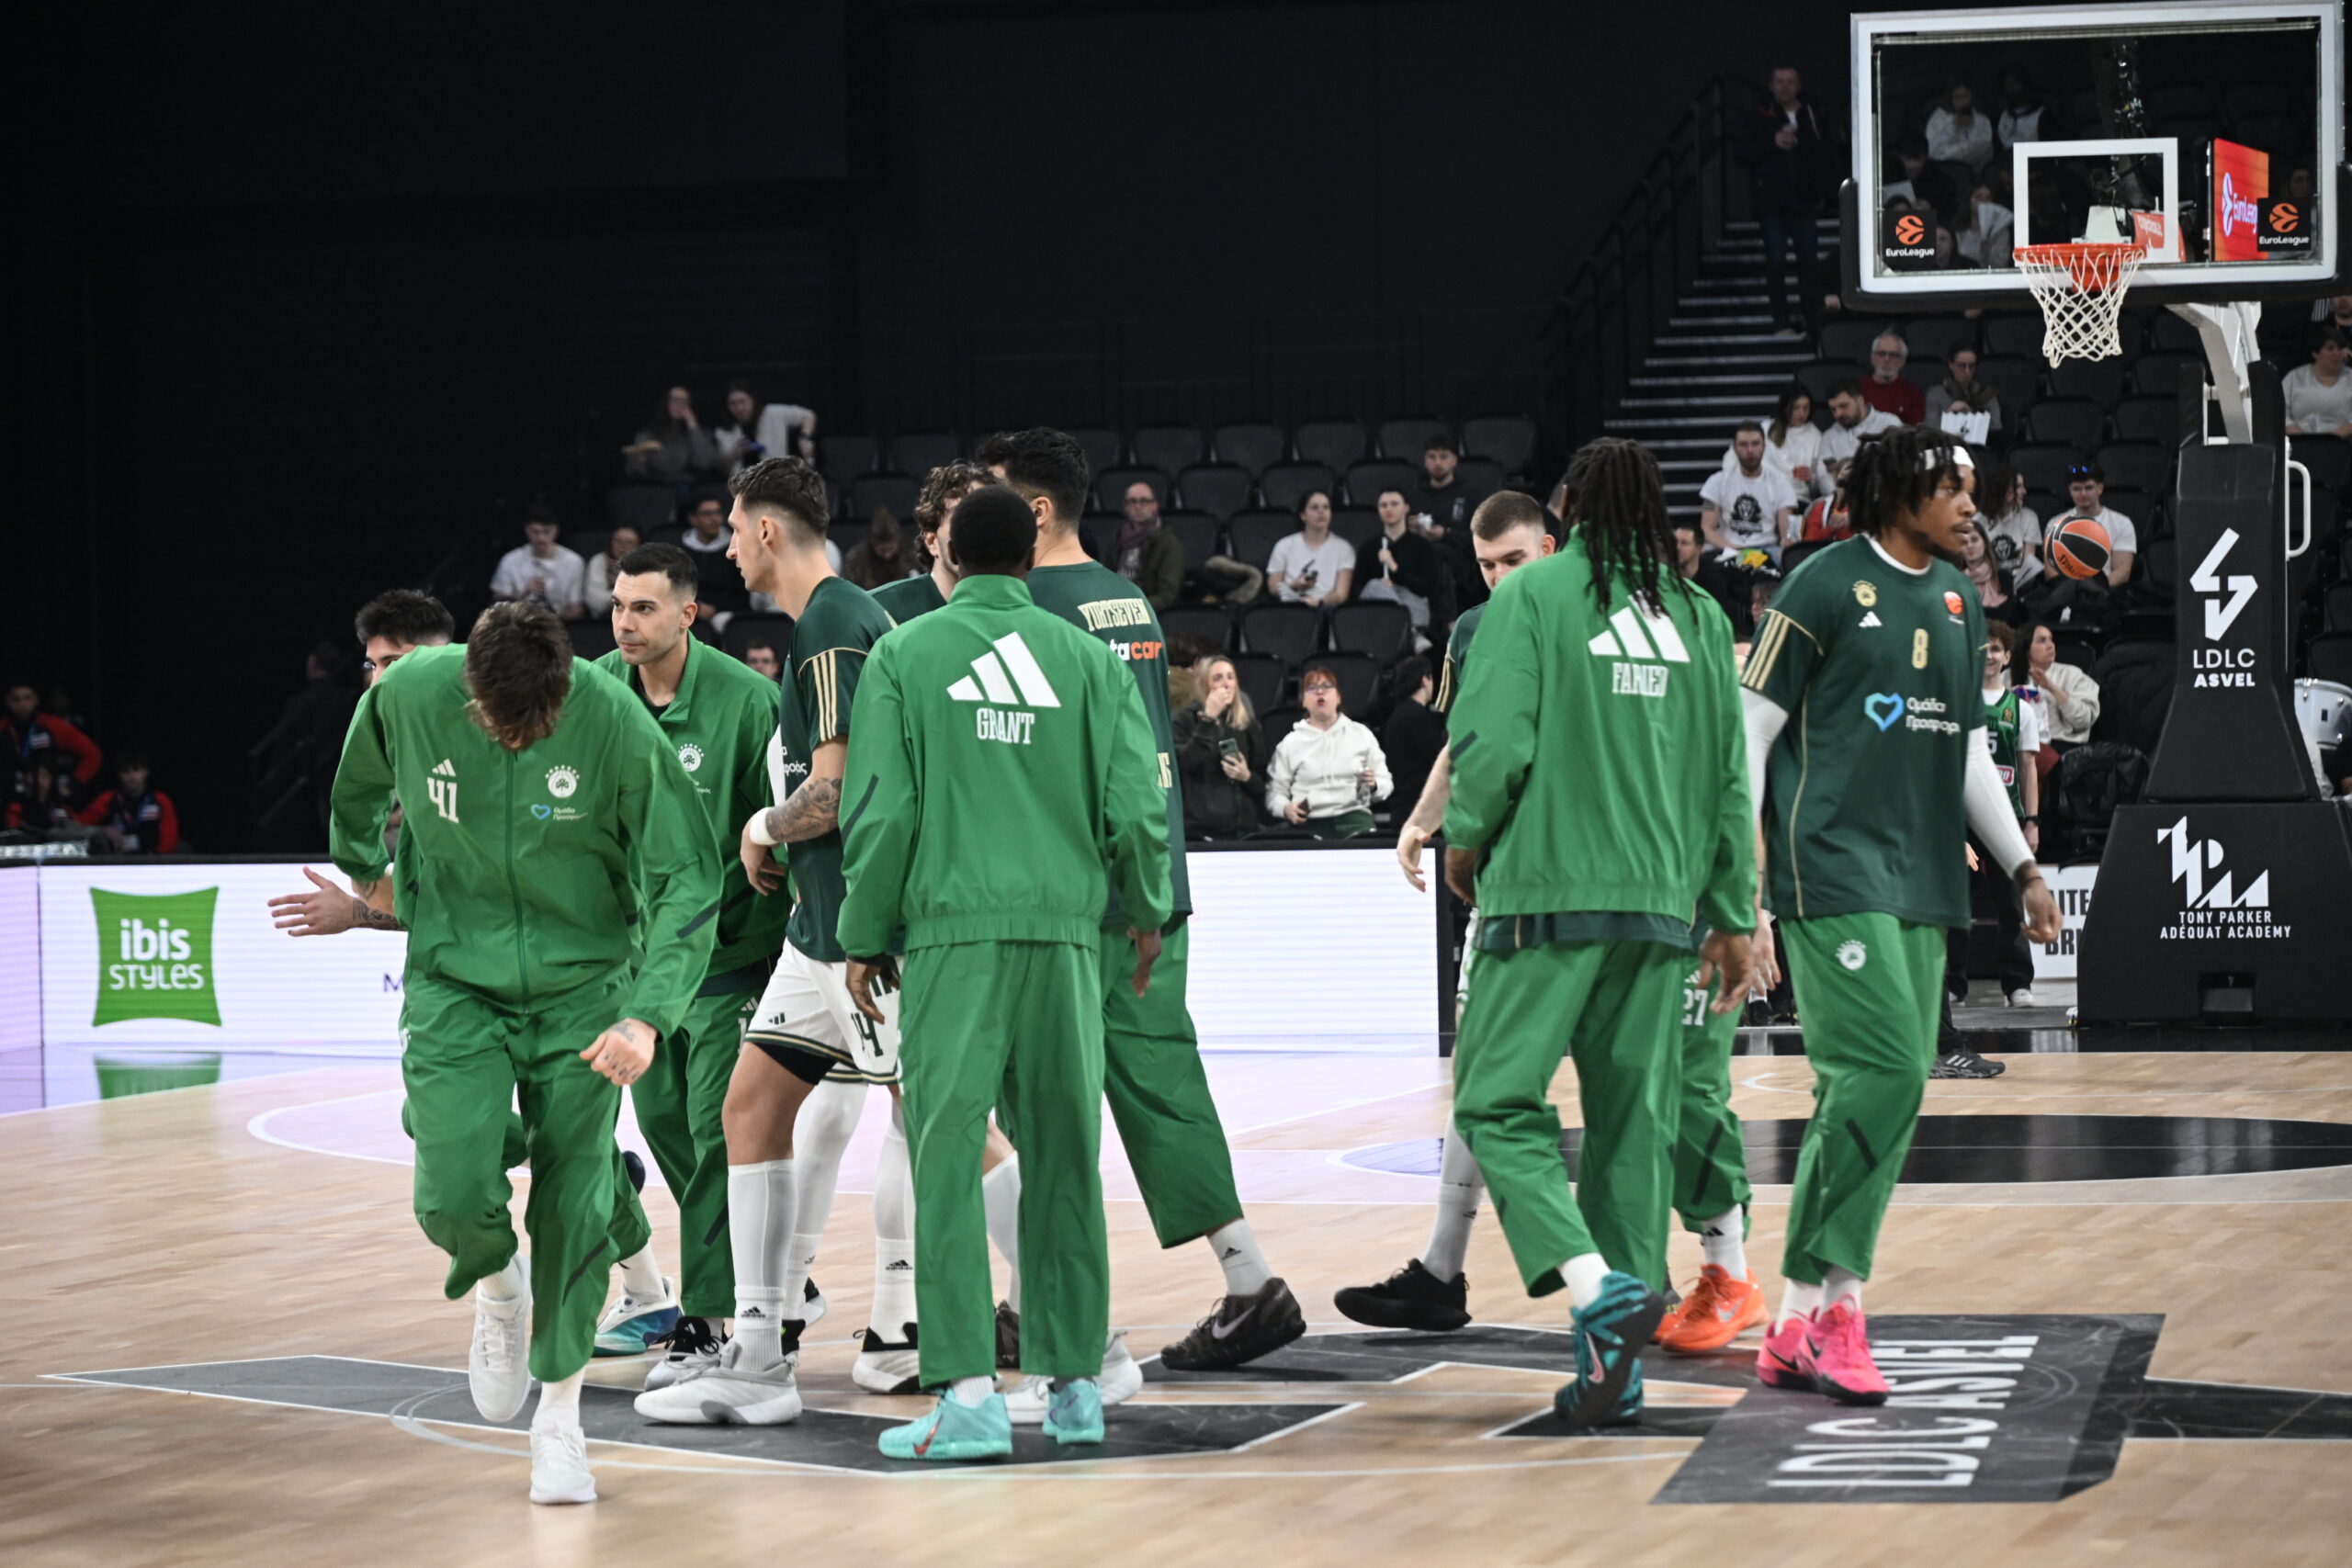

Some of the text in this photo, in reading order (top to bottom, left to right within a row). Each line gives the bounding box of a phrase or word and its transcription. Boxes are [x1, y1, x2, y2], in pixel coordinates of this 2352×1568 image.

[2258, 236, 2310, 246] EuroLeague
[1885, 247, 1935, 258] EuroLeague
[1109, 638, 1162, 660] tacar
[1912, 627, 1928, 669] 8
[2193, 648, 2256, 669] LDLC
[2193, 672, 2256, 688] ASVEL
[976, 707, 1035, 744] GRANT
[426, 777, 459, 824] 41
[2179, 910, 2272, 924] TONY PARKER
[120, 919, 191, 961] ibis
[2160, 924, 2290, 939] ADÉQUAT ACADEMY
[1765, 1416, 2000, 1486] LDLC
